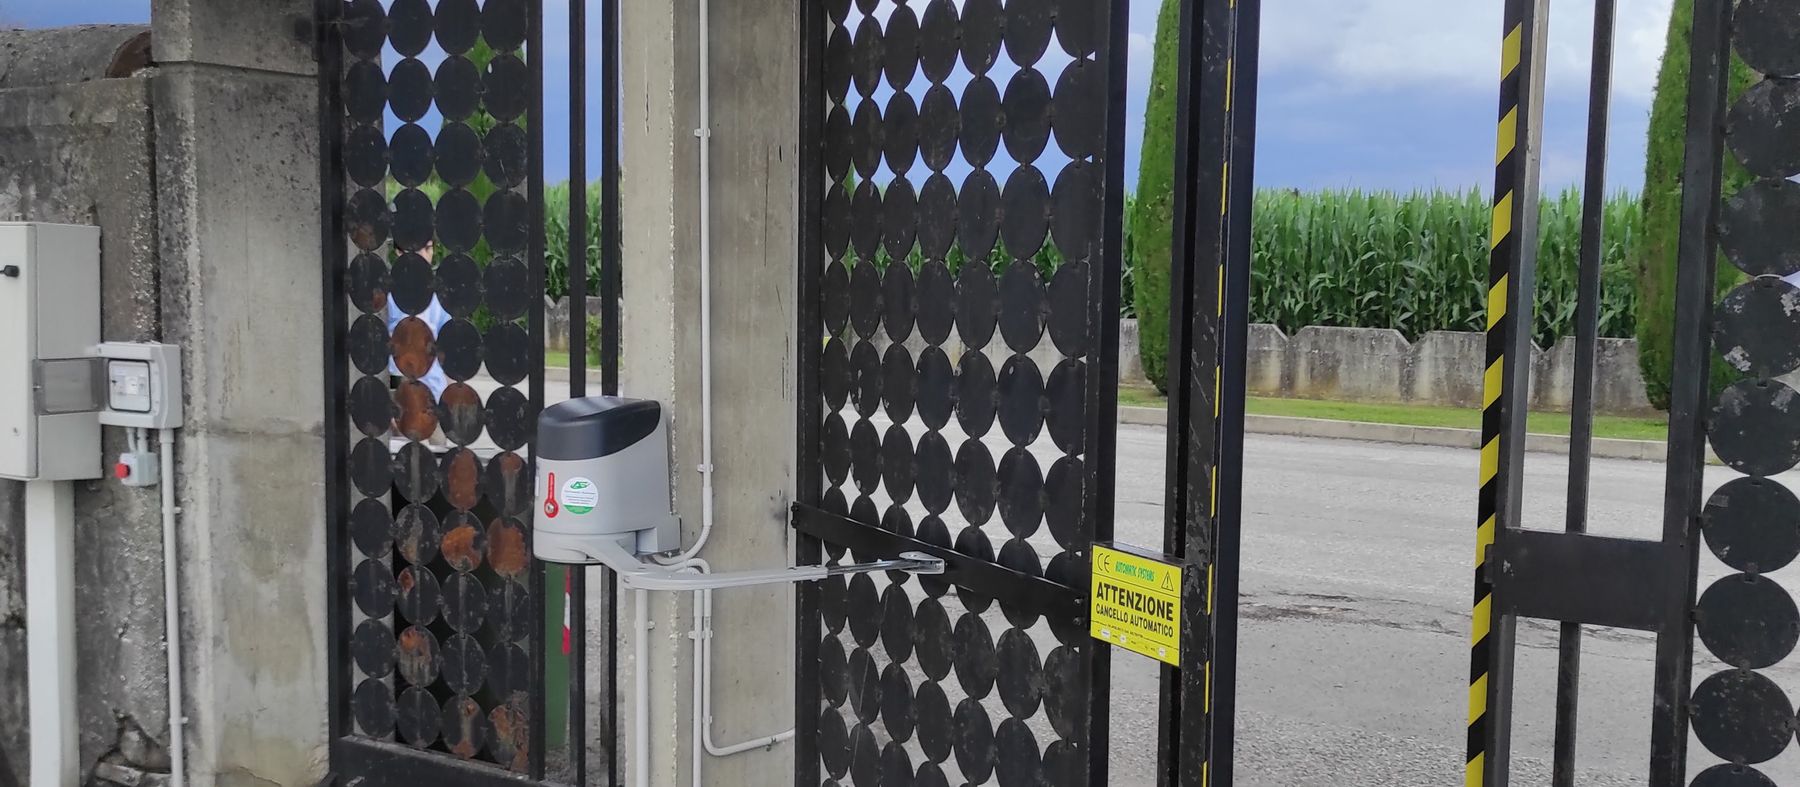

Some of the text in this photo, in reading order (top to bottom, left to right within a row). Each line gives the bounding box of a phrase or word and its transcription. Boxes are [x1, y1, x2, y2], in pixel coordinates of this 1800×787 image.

[1098, 553, 1110, 573] CE
[1115, 561, 1154, 582] AUTOMATIC SYSTEMS
[1096, 582, 1174, 621] ATTENZIONE
[1096, 603, 1128, 623] CANCELLO
[1130, 614, 1174, 638] AUTOMATICO
